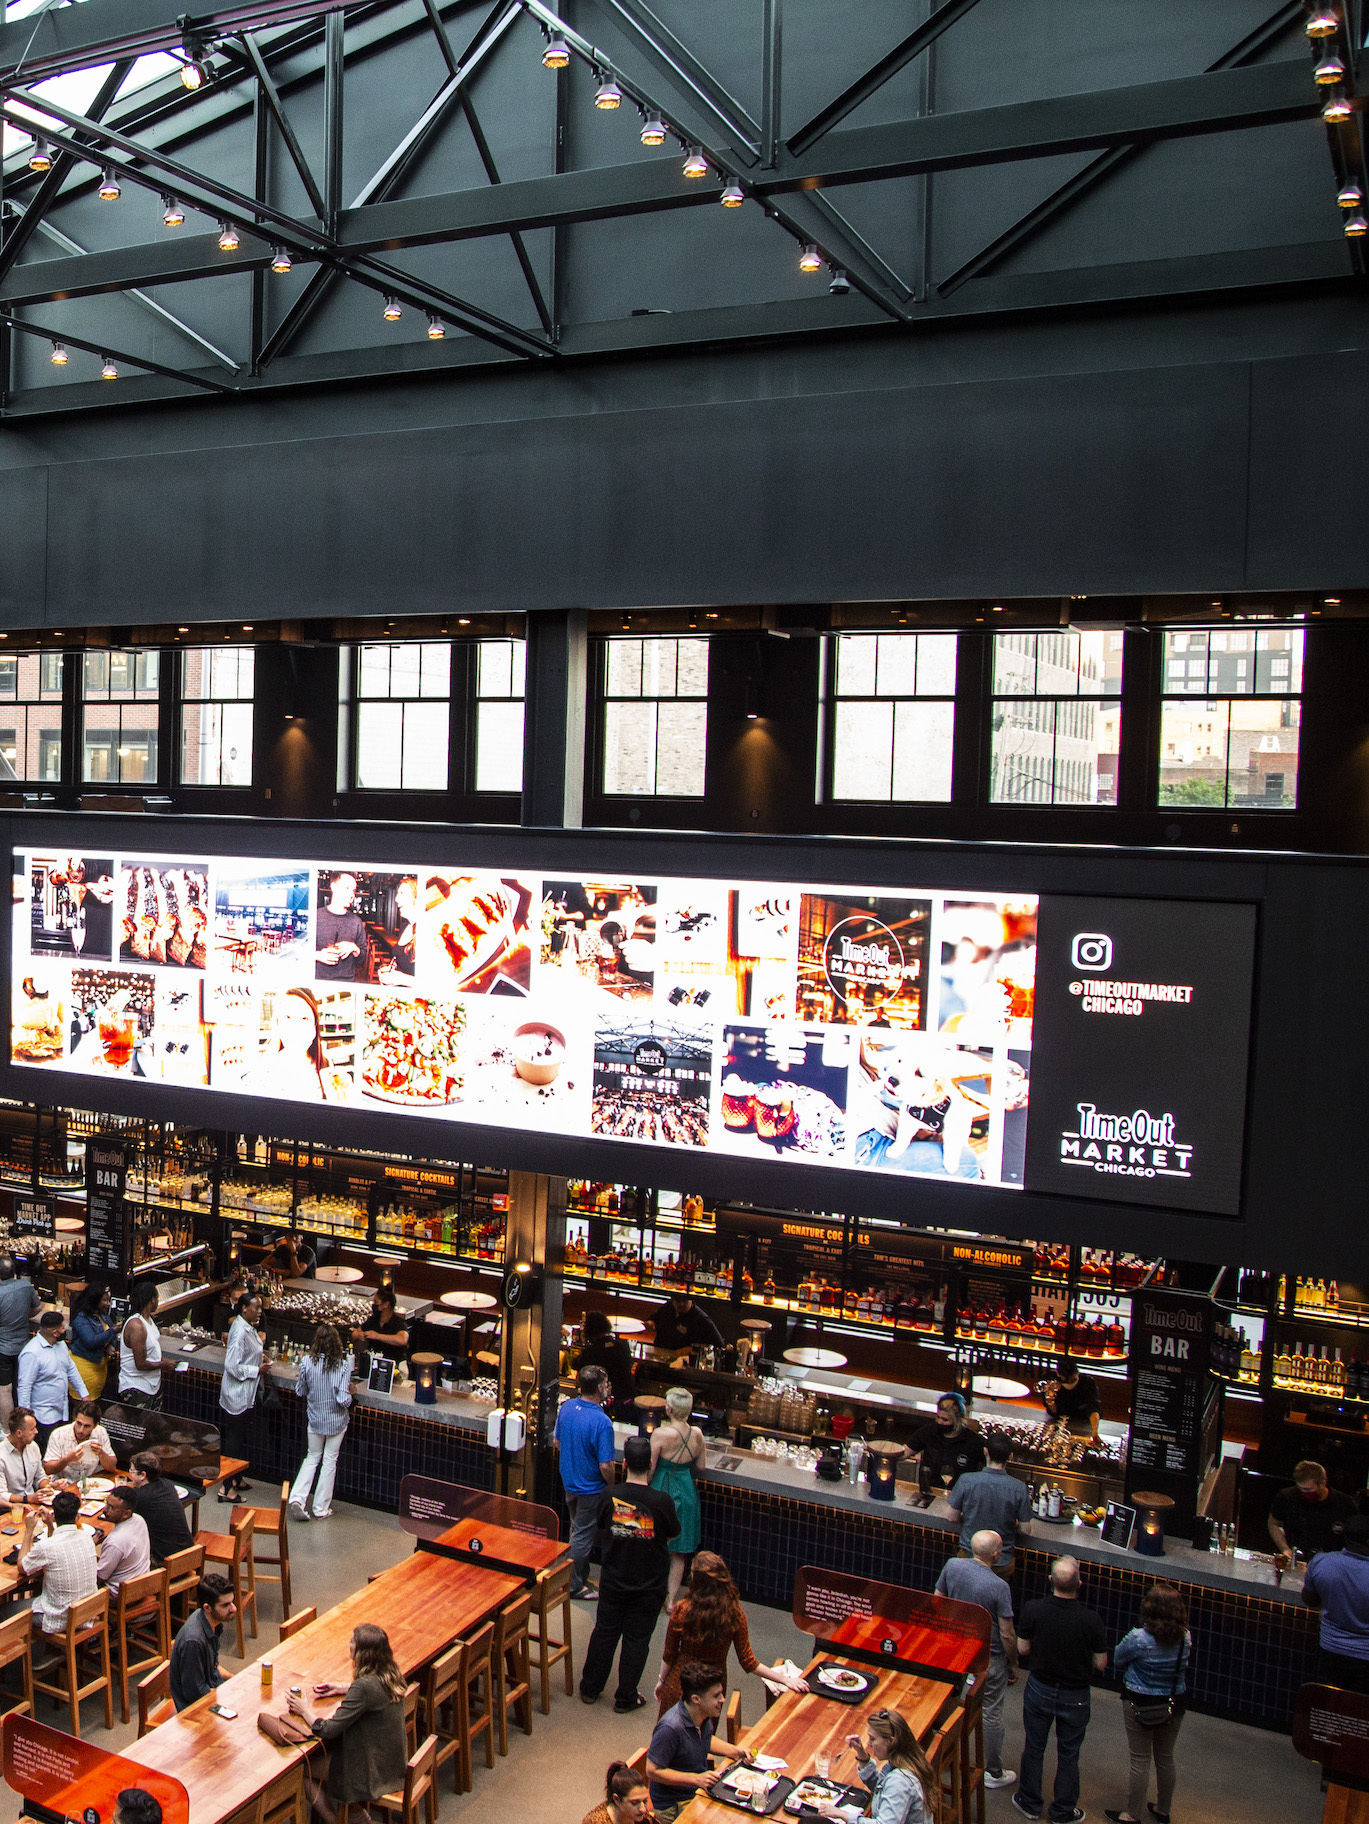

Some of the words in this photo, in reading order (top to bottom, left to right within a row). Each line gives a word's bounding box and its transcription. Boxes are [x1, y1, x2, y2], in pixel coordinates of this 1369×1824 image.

[1068, 979, 1193, 1003] @TIMEOUTMARKET
[1082, 996, 1142, 1016] CHICAGO
[1060, 1139, 1193, 1169] MARKET
[96, 1170, 118, 1188] BAR
[384, 1166, 419, 1180] SIGNATURE
[420, 1172, 455, 1186] COCKTAILS
[1094, 1161, 1156, 1178] CHICAGO
[16, 1210, 39, 1220] MARKET
[40, 1213, 51, 1222] APP
[21, 1202, 34, 1212] TIME
[36, 1204, 46, 1214] OUT
[782, 1223, 825, 1240] SIGNATURE
[953, 1246, 1022, 1266] NON-ALCOHOLIC
[1150, 1335, 1190, 1360] BAR
